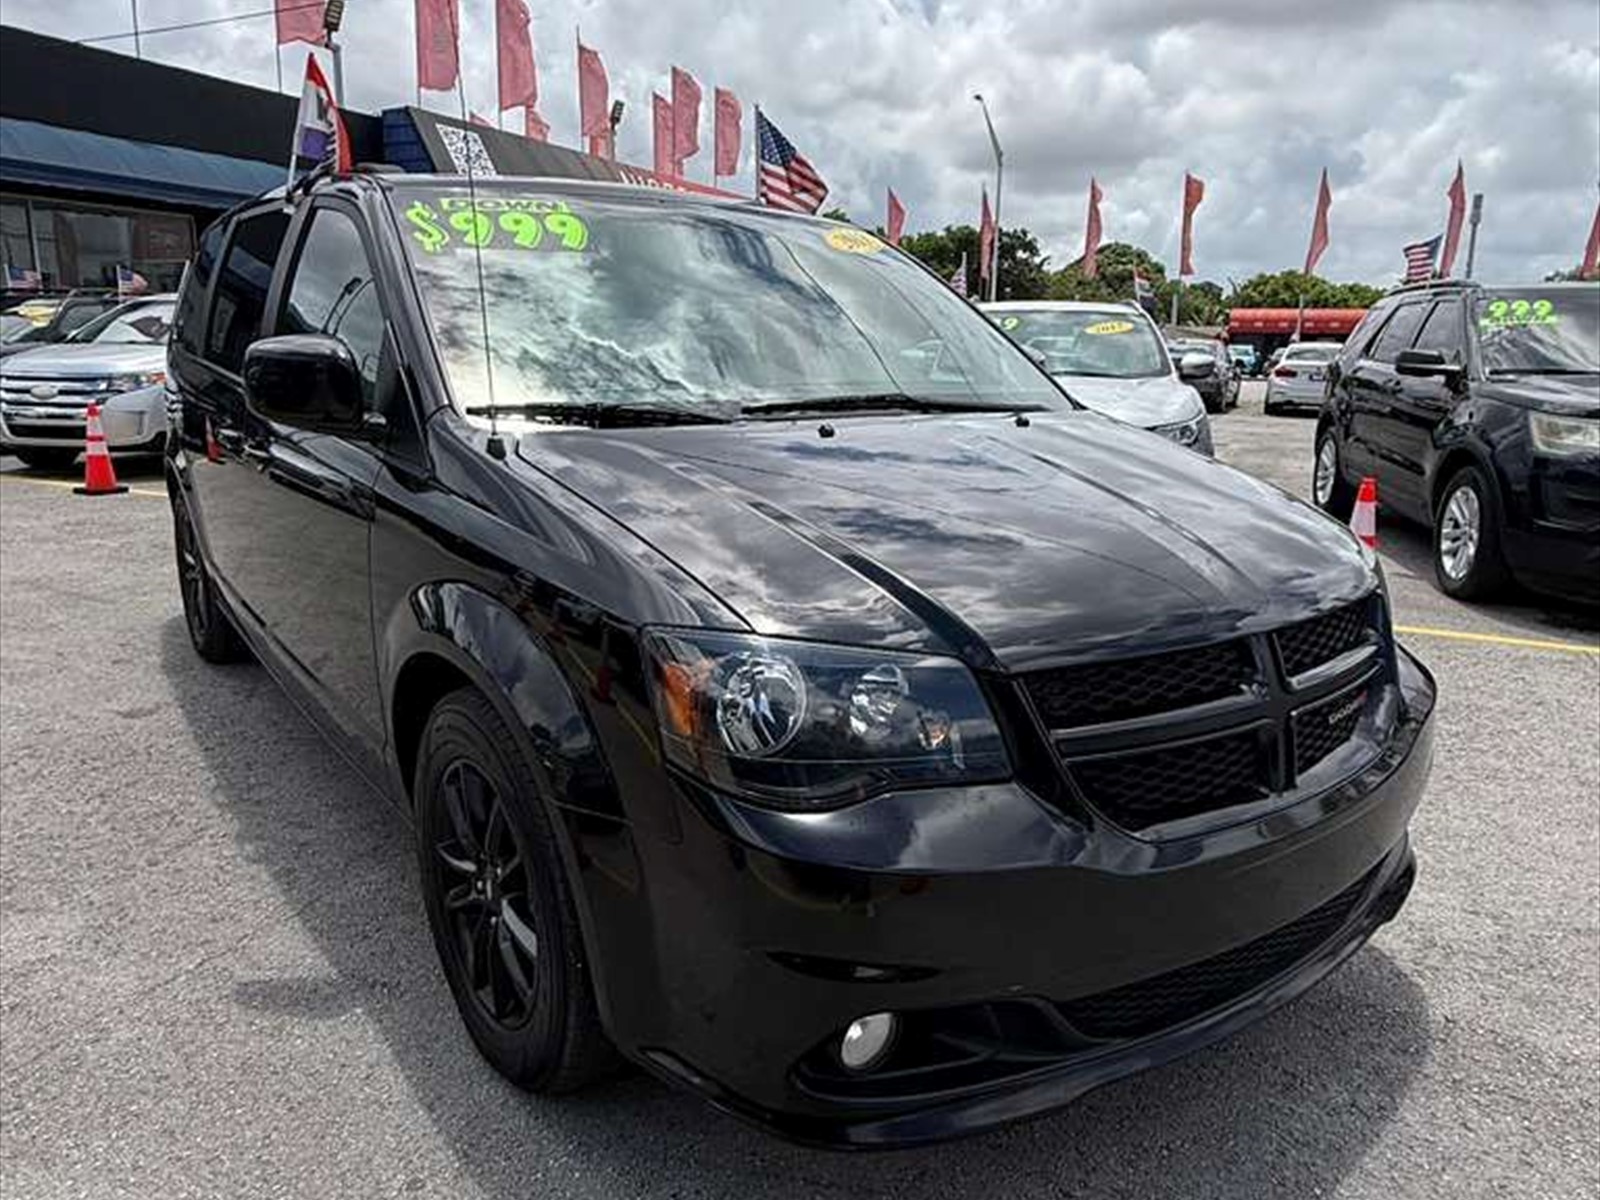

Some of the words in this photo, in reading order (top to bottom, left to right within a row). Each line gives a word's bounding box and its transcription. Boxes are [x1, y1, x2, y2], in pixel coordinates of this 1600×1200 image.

[444, 199, 563, 213] DOWN
[405, 201, 588, 252] $999
[1328, 698, 1361, 725] DOD
